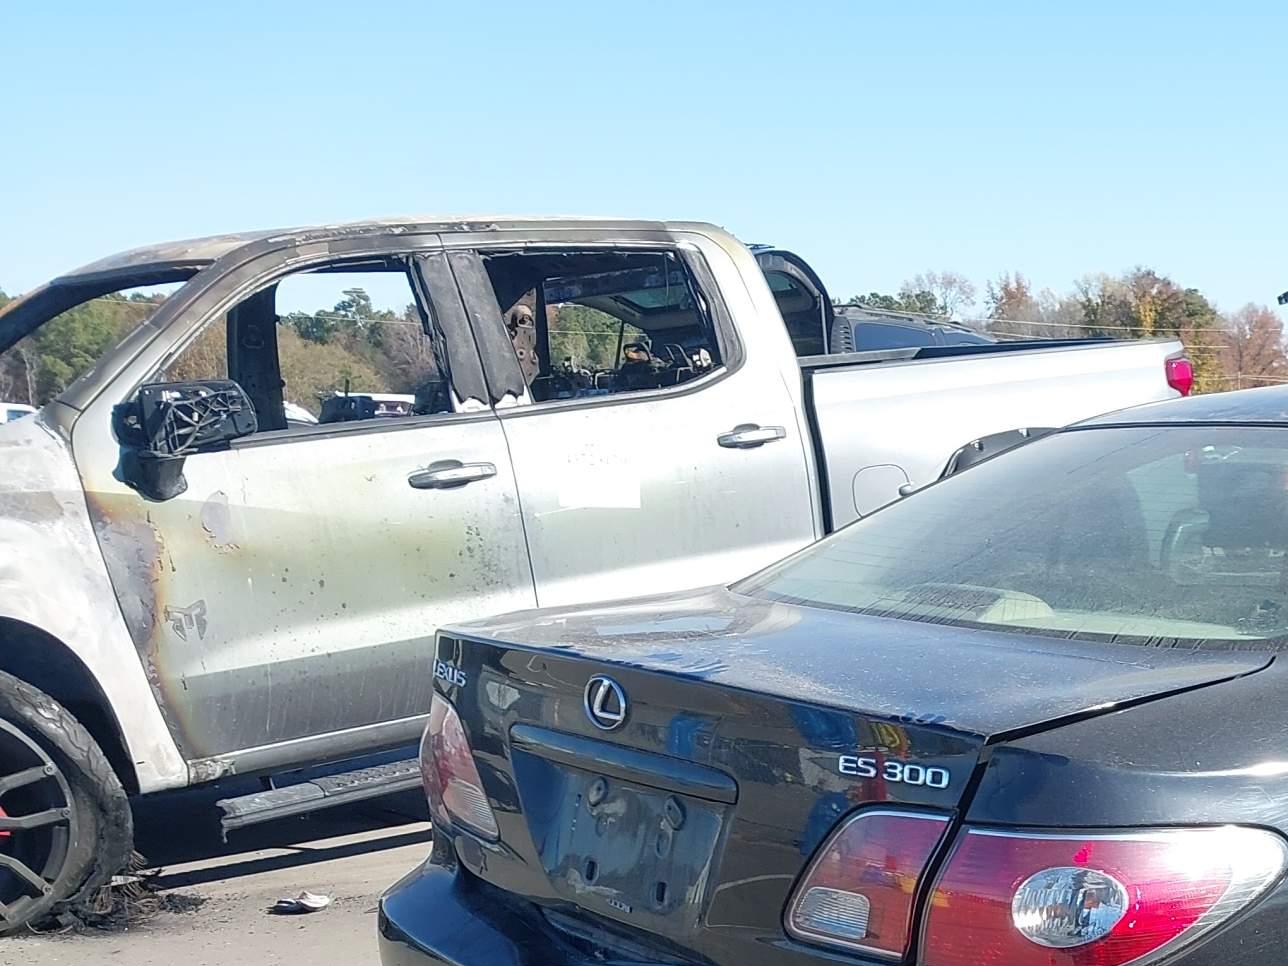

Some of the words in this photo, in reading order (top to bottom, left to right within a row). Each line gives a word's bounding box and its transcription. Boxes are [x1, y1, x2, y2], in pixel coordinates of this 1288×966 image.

[433, 659, 467, 687] LEXUS
[838, 755, 877, 778] ES
[882, 761, 950, 789] 300
